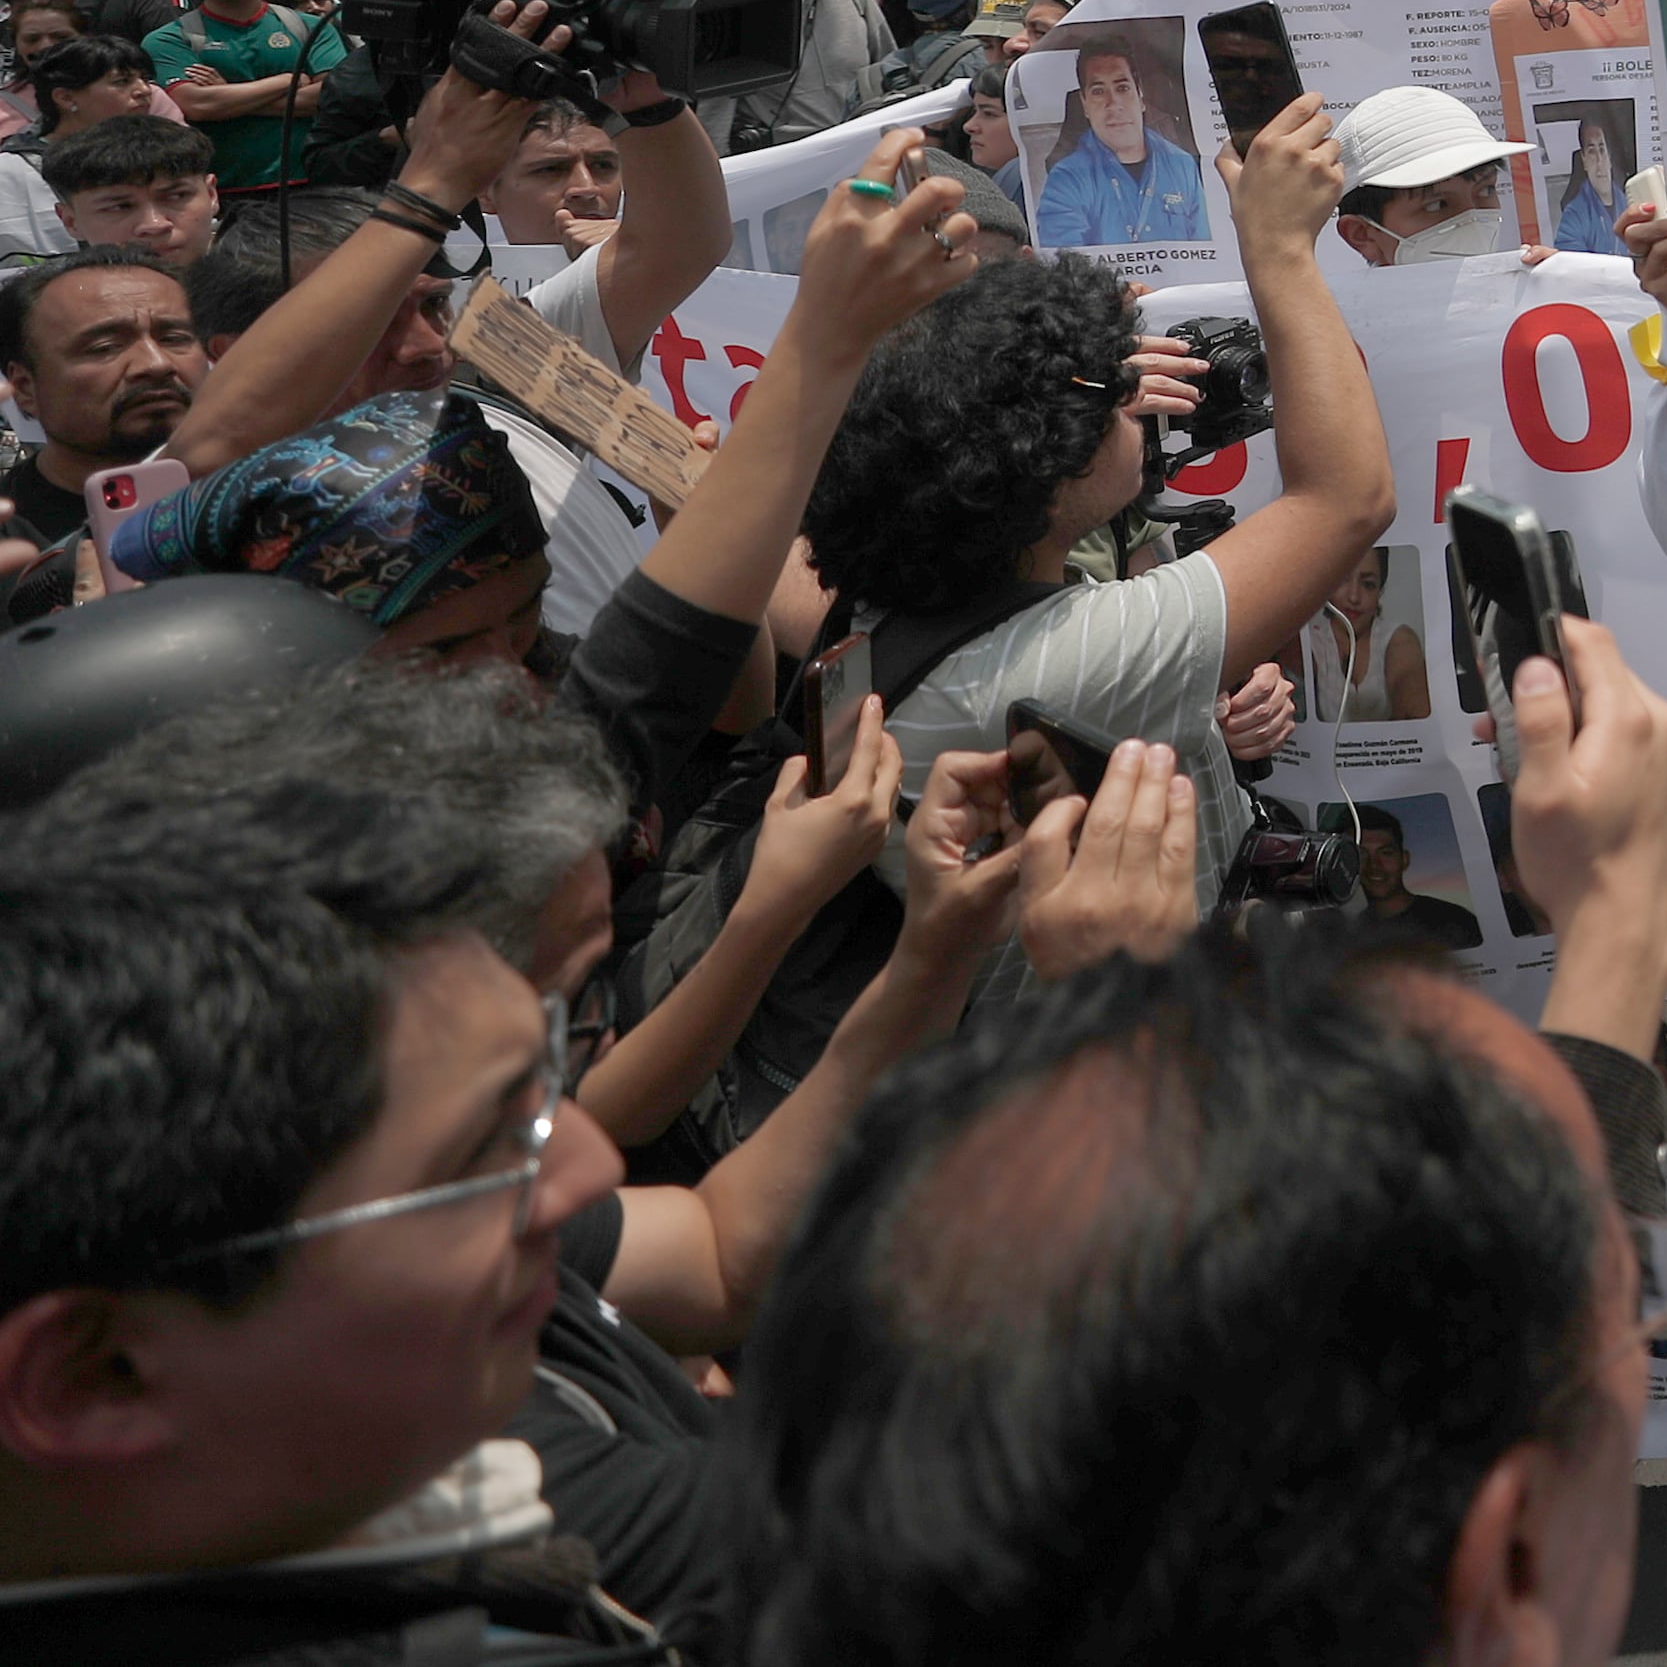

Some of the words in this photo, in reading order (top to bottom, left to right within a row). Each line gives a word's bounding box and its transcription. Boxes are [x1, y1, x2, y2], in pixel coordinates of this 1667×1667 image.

[362, 7, 395, 17] SONY
[1419, 10, 1466, 20] REPORTE:
[1420, 24, 1471, 34] AUSENCIA:
[1440, 38, 1480, 47] HOMBRE
[1616, 60, 1653, 71] BOLE
[1098, 250, 1168, 263] ALBERTO
[1171, 250, 1216, 260] GOMEZ
[1115, 264, 1163, 276] ARCIA
